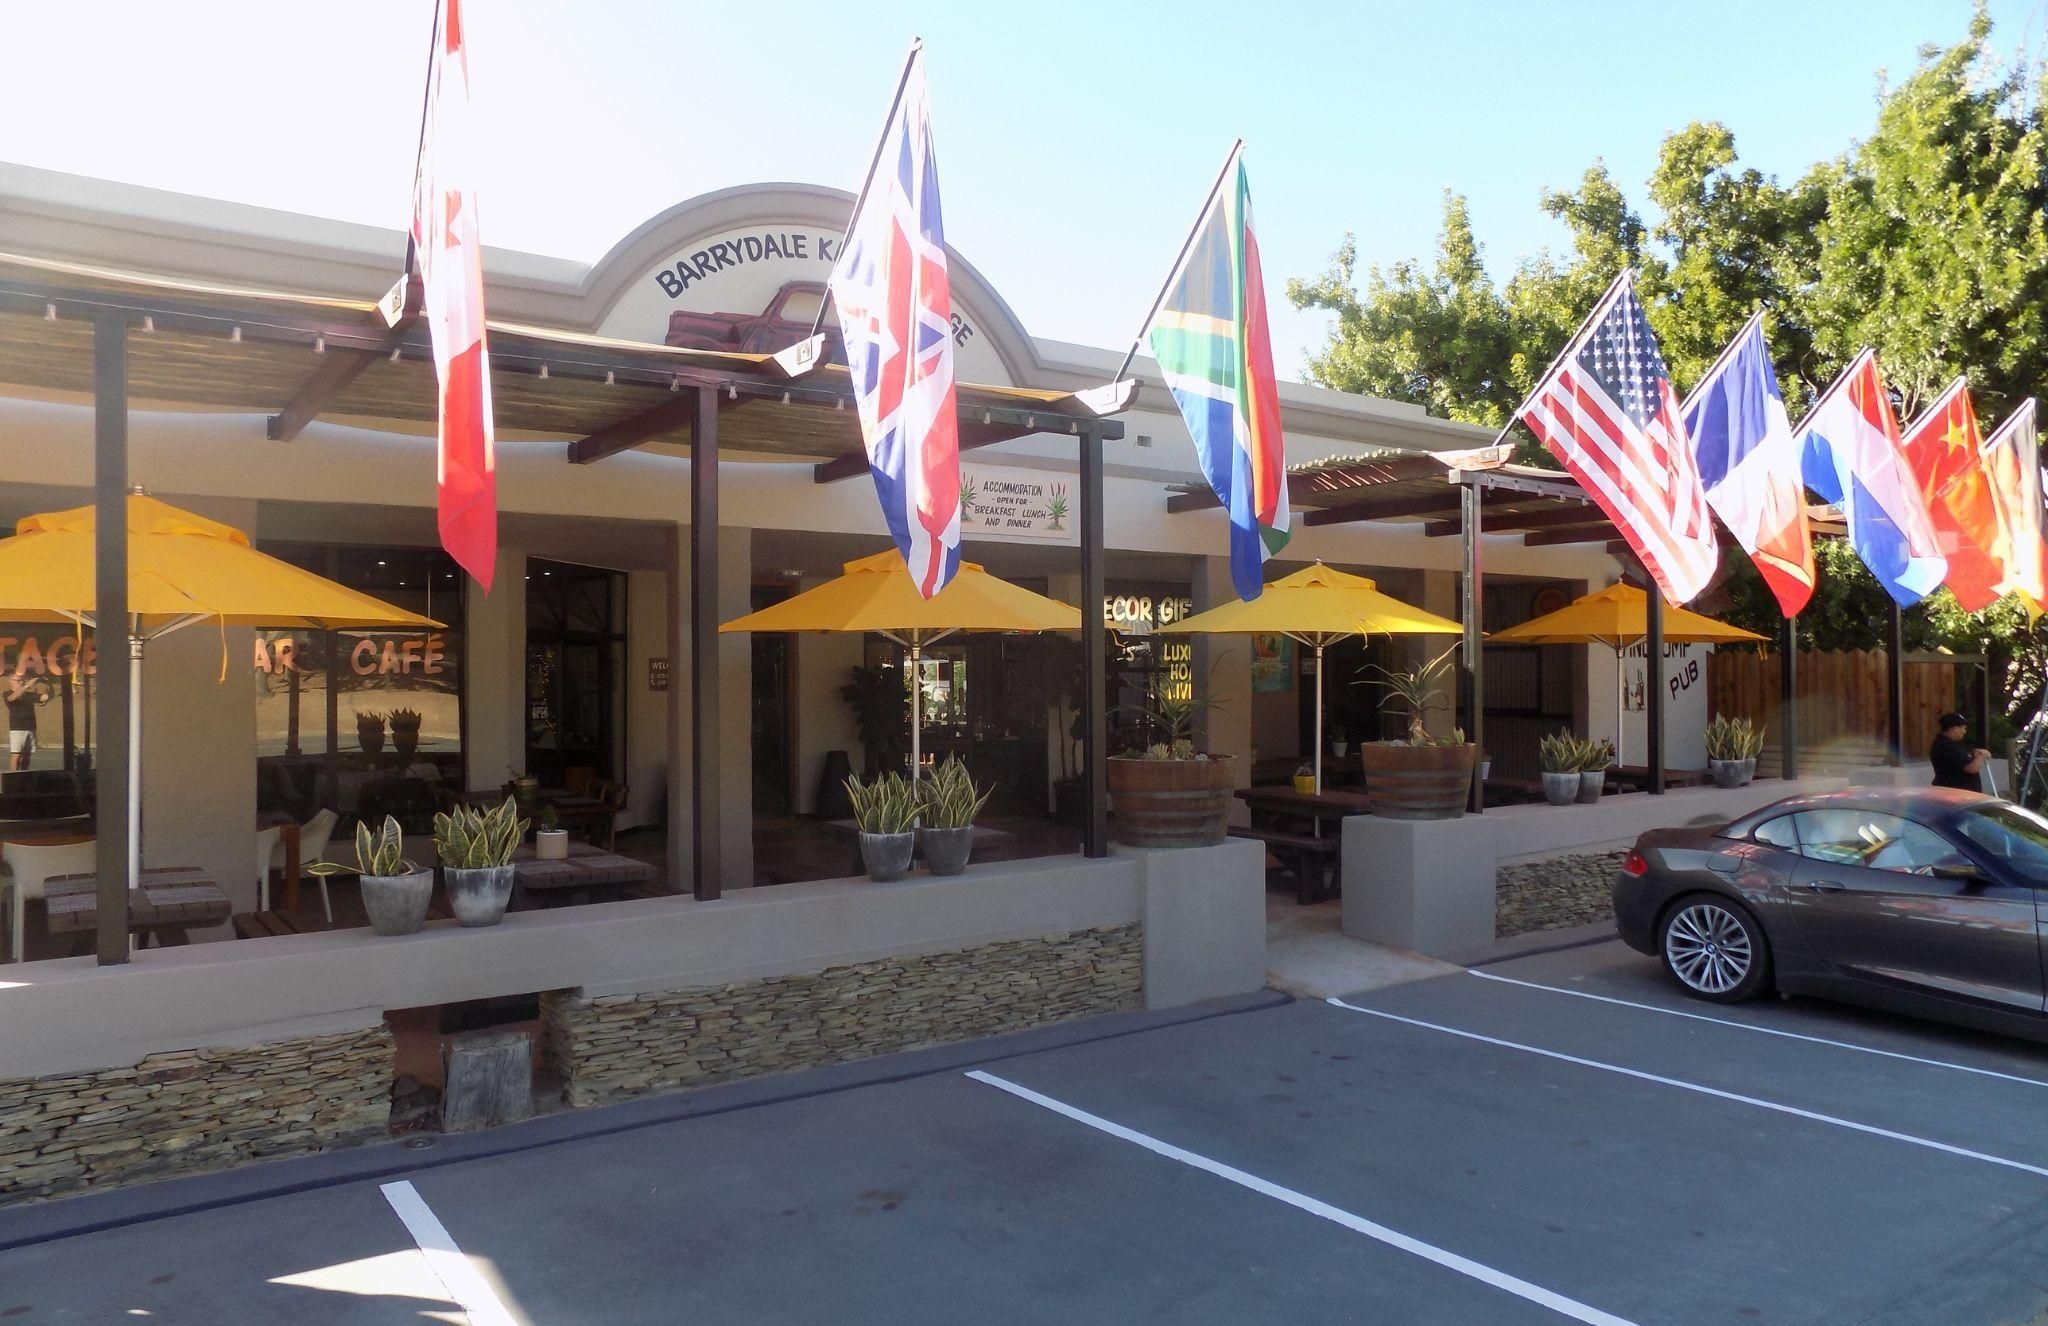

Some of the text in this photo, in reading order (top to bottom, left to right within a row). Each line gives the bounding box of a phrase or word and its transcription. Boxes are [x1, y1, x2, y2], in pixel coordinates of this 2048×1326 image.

[655, 233, 808, 299] BARRYDALE
[950, 312, 974, 348] GE
[983, 481, 1043, 497] ACCOMMODATION
[996, 496, 1014, 504] OPEN
[974, 505, 1047, 519] BREAKFAST LUNCH
[985, 517, 1032, 529] AND DINNER
[1104, 595, 1152, 622] ECOR
[255, 638, 299, 675] AR
[351, 633, 444, 676] CAFÉ
[1163, 643, 1191, 661] LUX
[1170, 663, 1191, 680] HO
[1669, 659, 1699, 701] PUB
